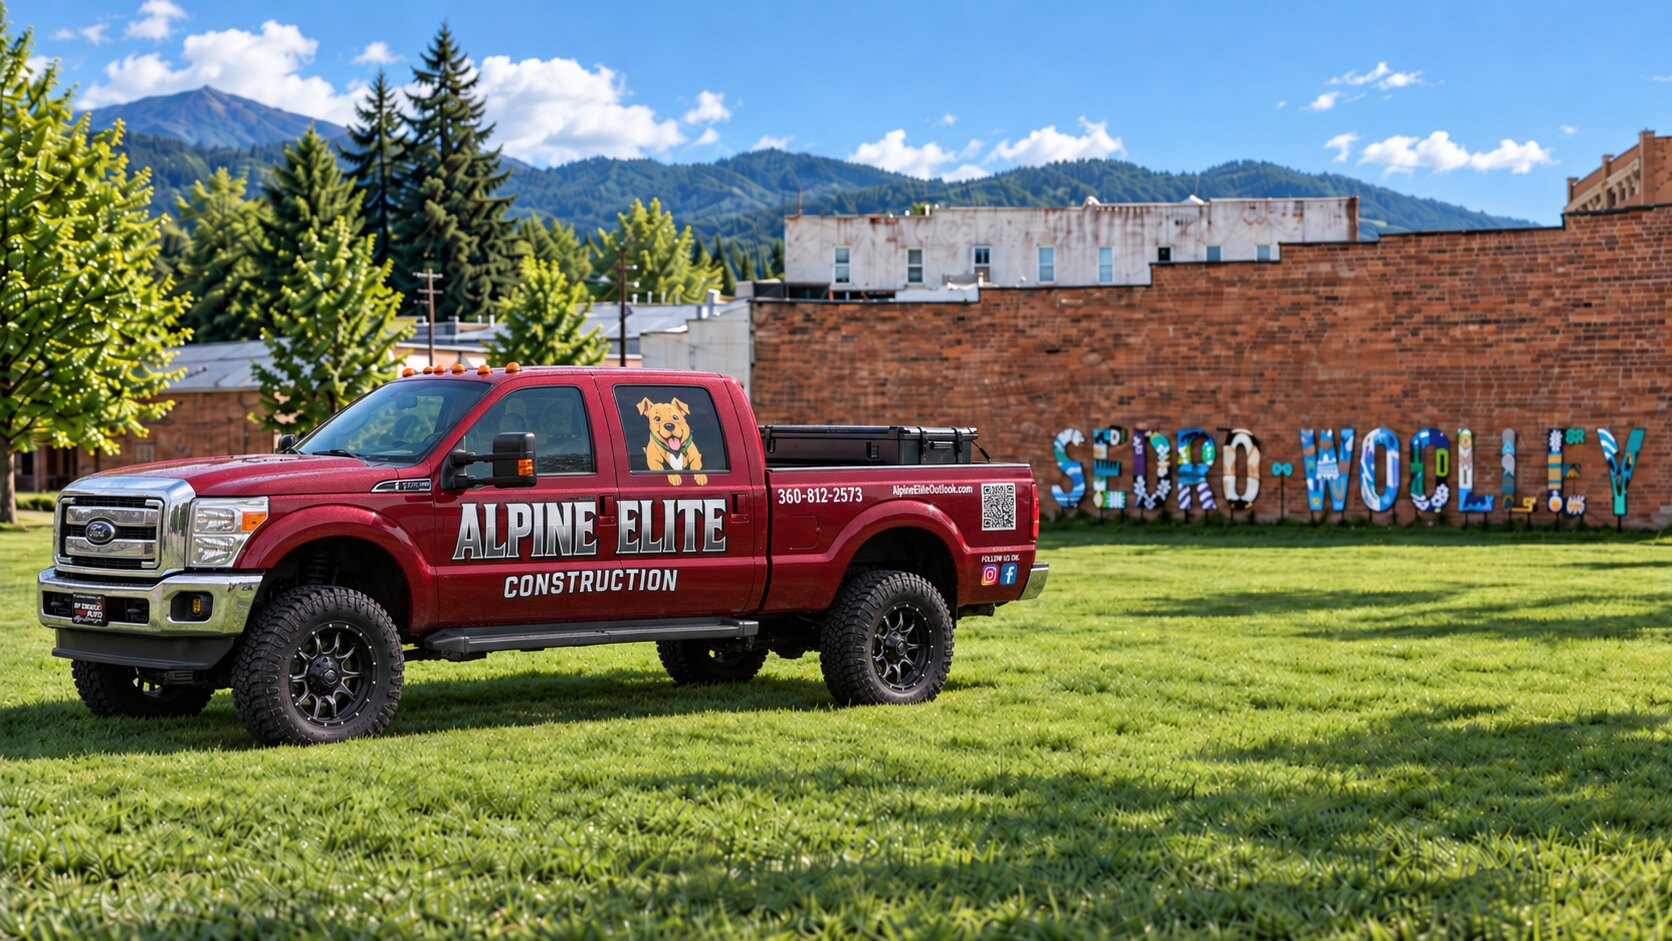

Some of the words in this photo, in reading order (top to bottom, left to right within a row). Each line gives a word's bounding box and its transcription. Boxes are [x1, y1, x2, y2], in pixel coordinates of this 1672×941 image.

[777, 487, 863, 504] 360-812-2573
[451, 501, 598, 561] ALPINE
[615, 499, 727, 556] ELITE
[503, 569, 678, 599] CONSTRUCTION
